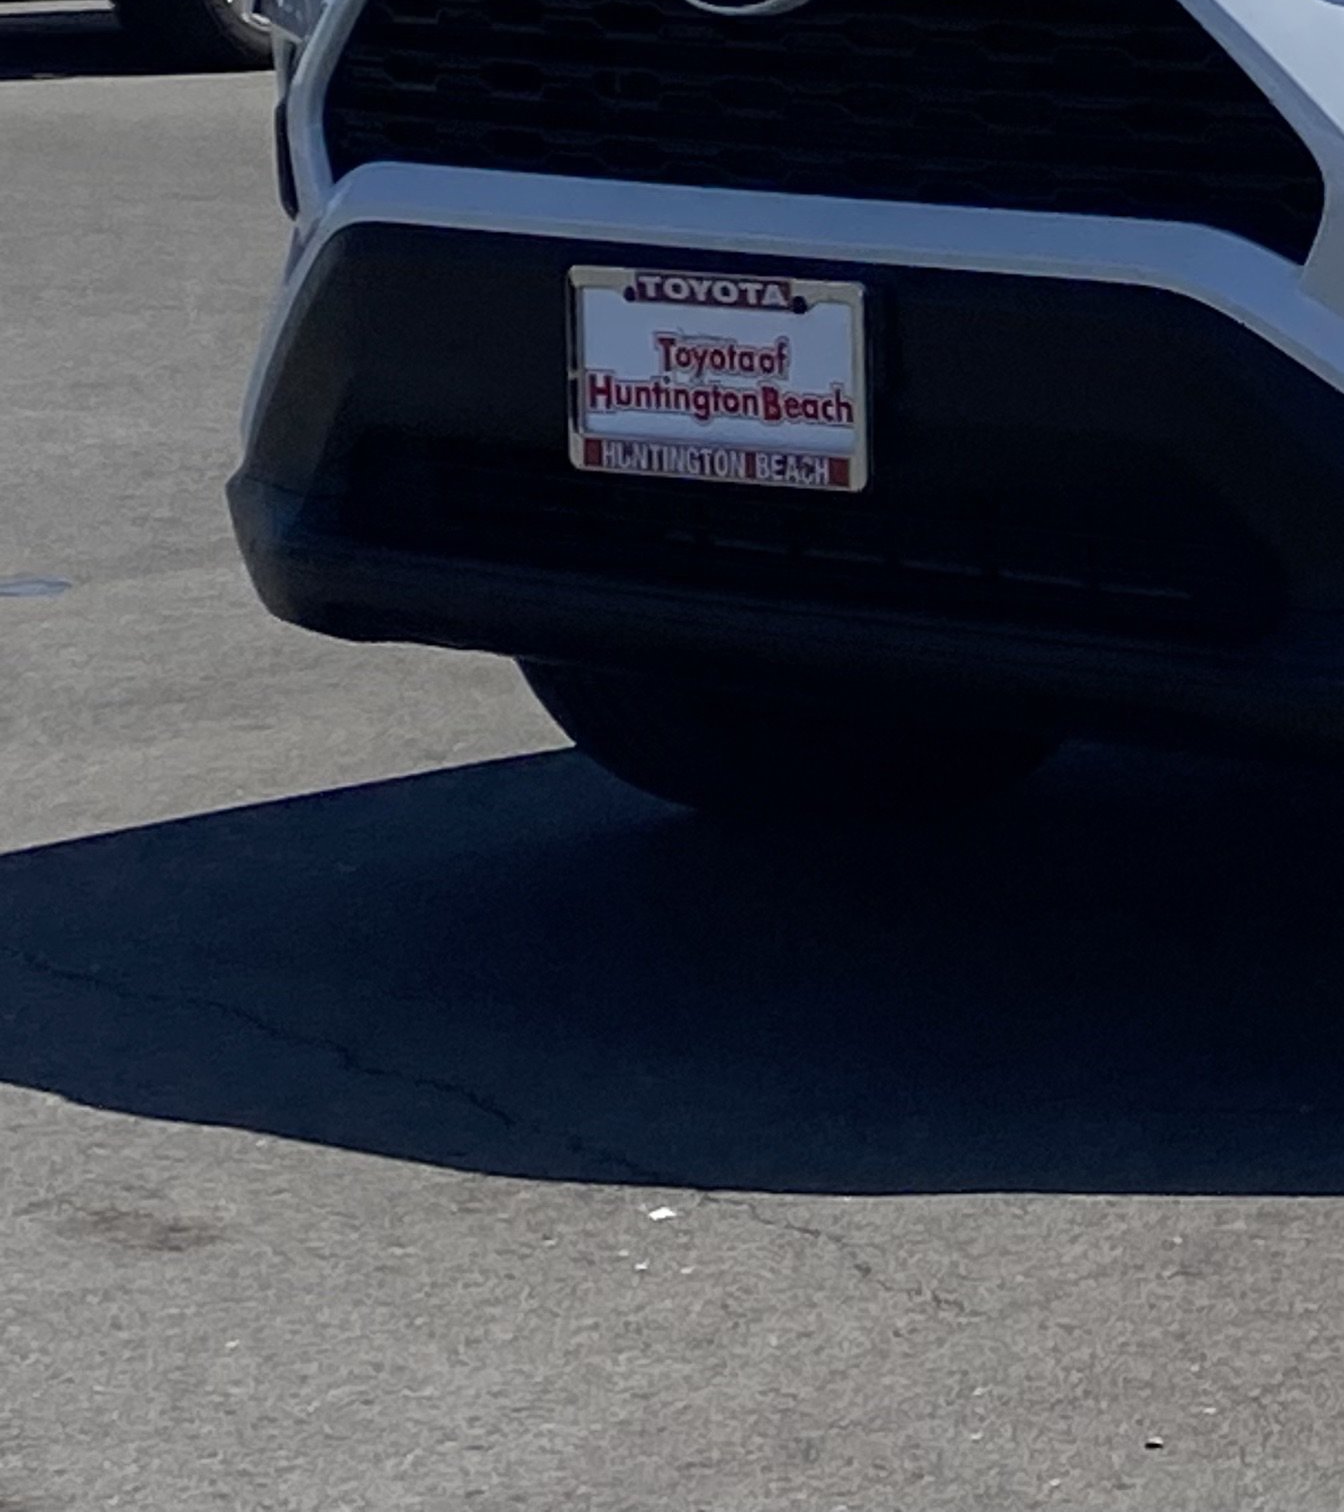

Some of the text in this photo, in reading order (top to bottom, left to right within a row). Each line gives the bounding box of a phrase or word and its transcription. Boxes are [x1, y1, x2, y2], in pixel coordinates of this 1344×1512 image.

[637, 275, 788, 308] TOYOTA
[658, 336, 790, 378] Toyota of
[587, 373, 854, 424] Huntington Beach
[602, 440, 830, 486] HUNTINGTON BEACH
